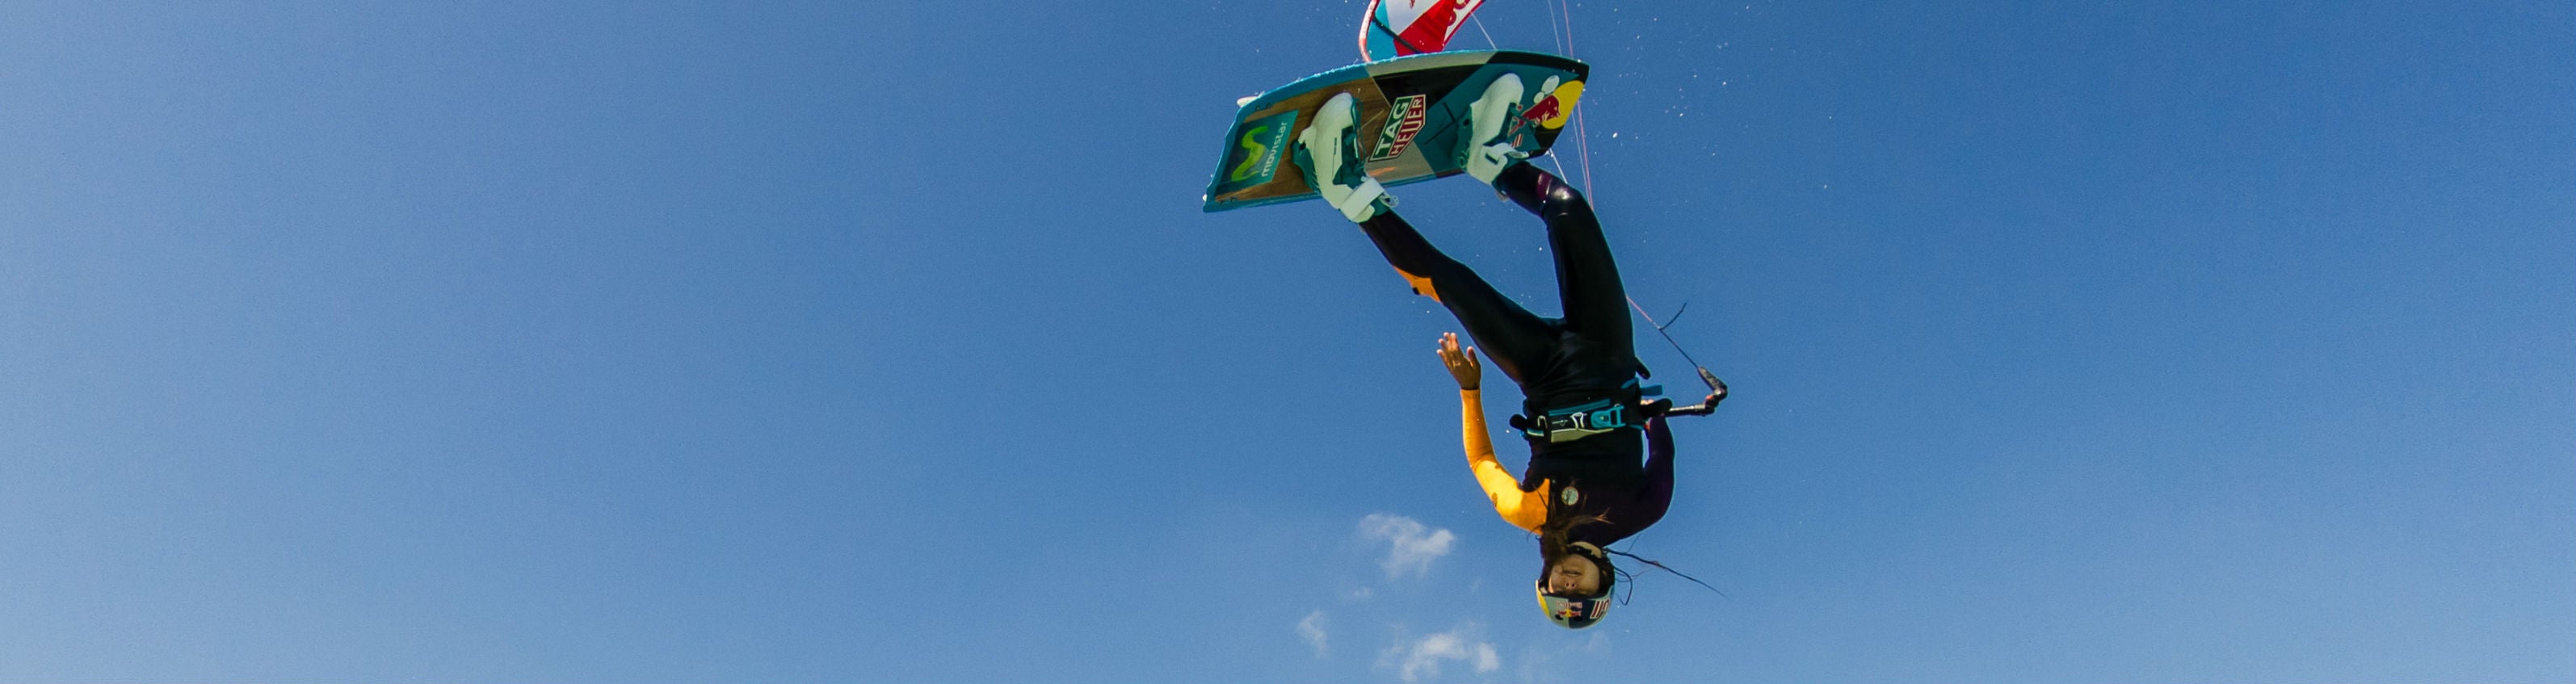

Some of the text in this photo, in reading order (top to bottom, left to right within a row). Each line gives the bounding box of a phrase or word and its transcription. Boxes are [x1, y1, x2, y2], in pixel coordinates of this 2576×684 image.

[1261, 121, 1288, 177] movistar
[1375, 102, 1410, 156] TAG
[1391, 99, 1422, 155] HEUER
